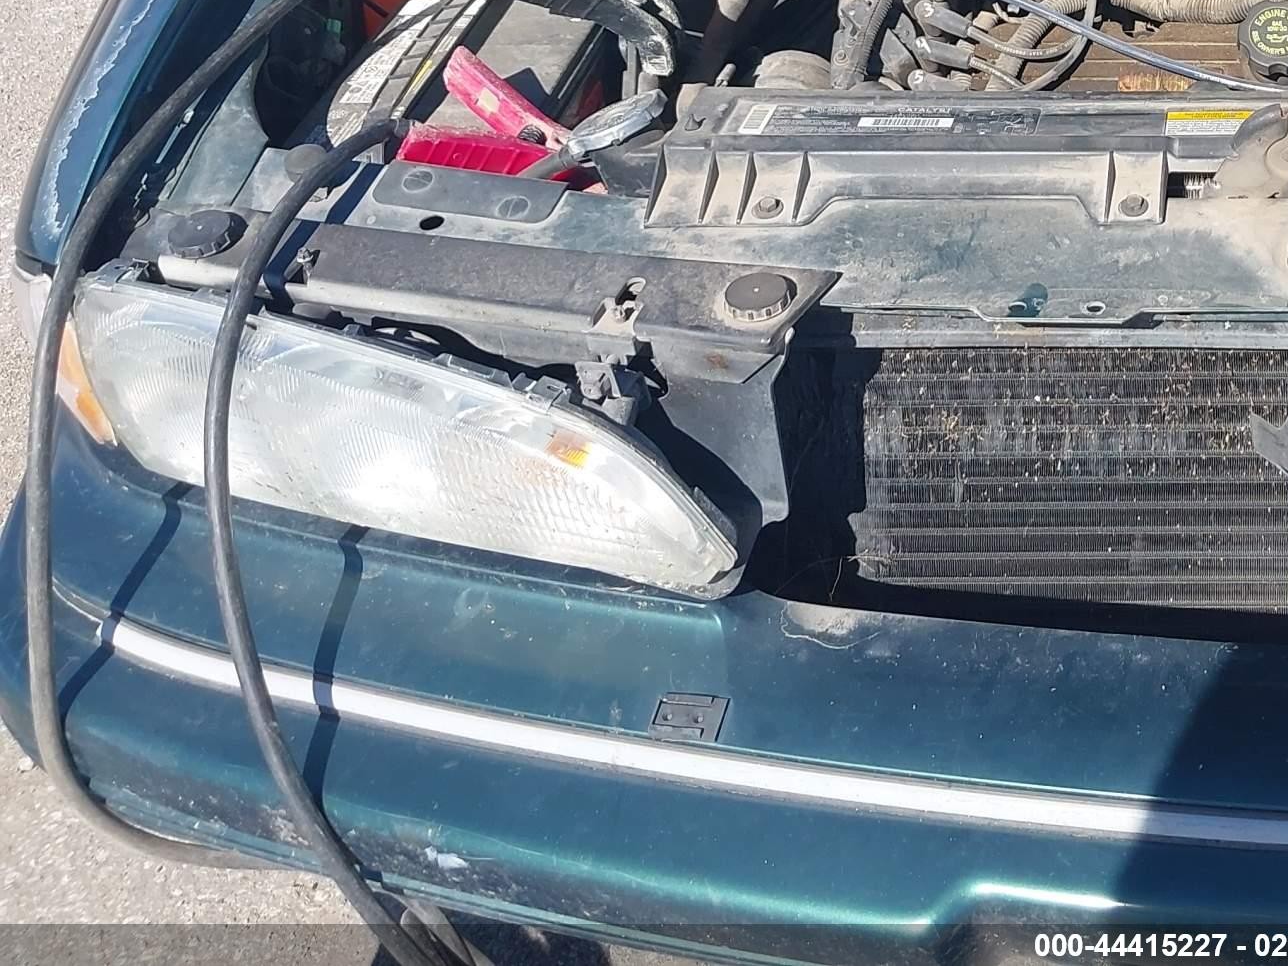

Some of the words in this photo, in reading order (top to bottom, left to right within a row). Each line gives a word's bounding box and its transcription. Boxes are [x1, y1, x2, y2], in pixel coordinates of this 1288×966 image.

[922, 1, 935, 18] 3
[1254, 9, 1287, 27] ENGINE
[913, 69, 924, 84] 5
